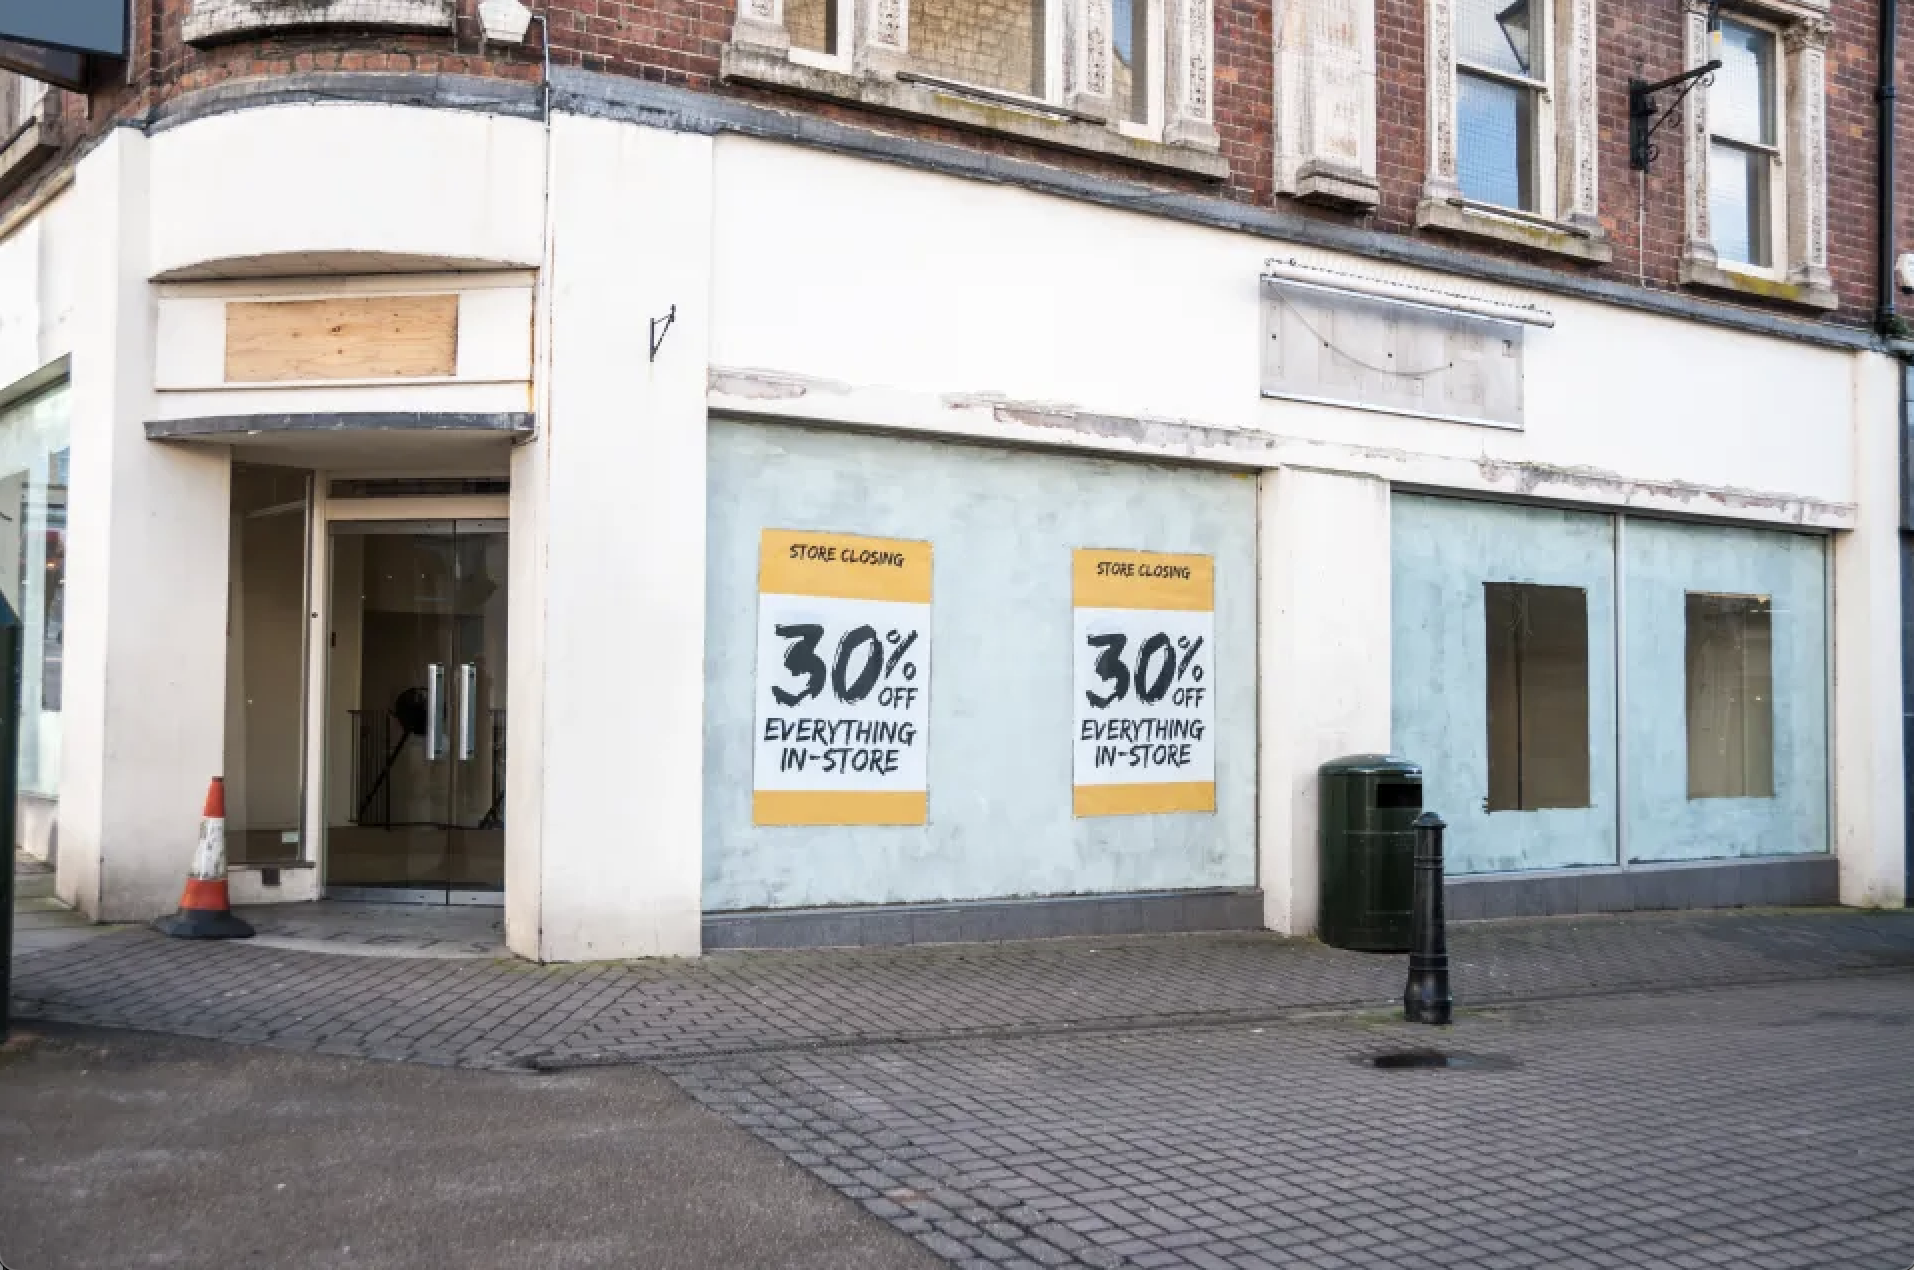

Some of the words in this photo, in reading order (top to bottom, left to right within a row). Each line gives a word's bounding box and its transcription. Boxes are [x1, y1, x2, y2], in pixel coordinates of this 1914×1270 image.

[790, 544, 836, 562] STORE
[840, 548, 904, 567] CLOSING
[1097, 562, 1134, 577] STORE
[1138, 564, 1191, 580] CLOSING
[771, 623, 918, 707] 30%
[1085, 632, 1204, 709] 30%
[878, 687, 918, 709] OFF
[1172, 688, 1206, 708] OFF
[764, 718, 916, 746] EVERYTHING
[1080, 718, 1206, 742] EVERYTHING
[780, 748, 899, 775] IN-STORE
[1095, 744, 1192, 768] IN-STORE
